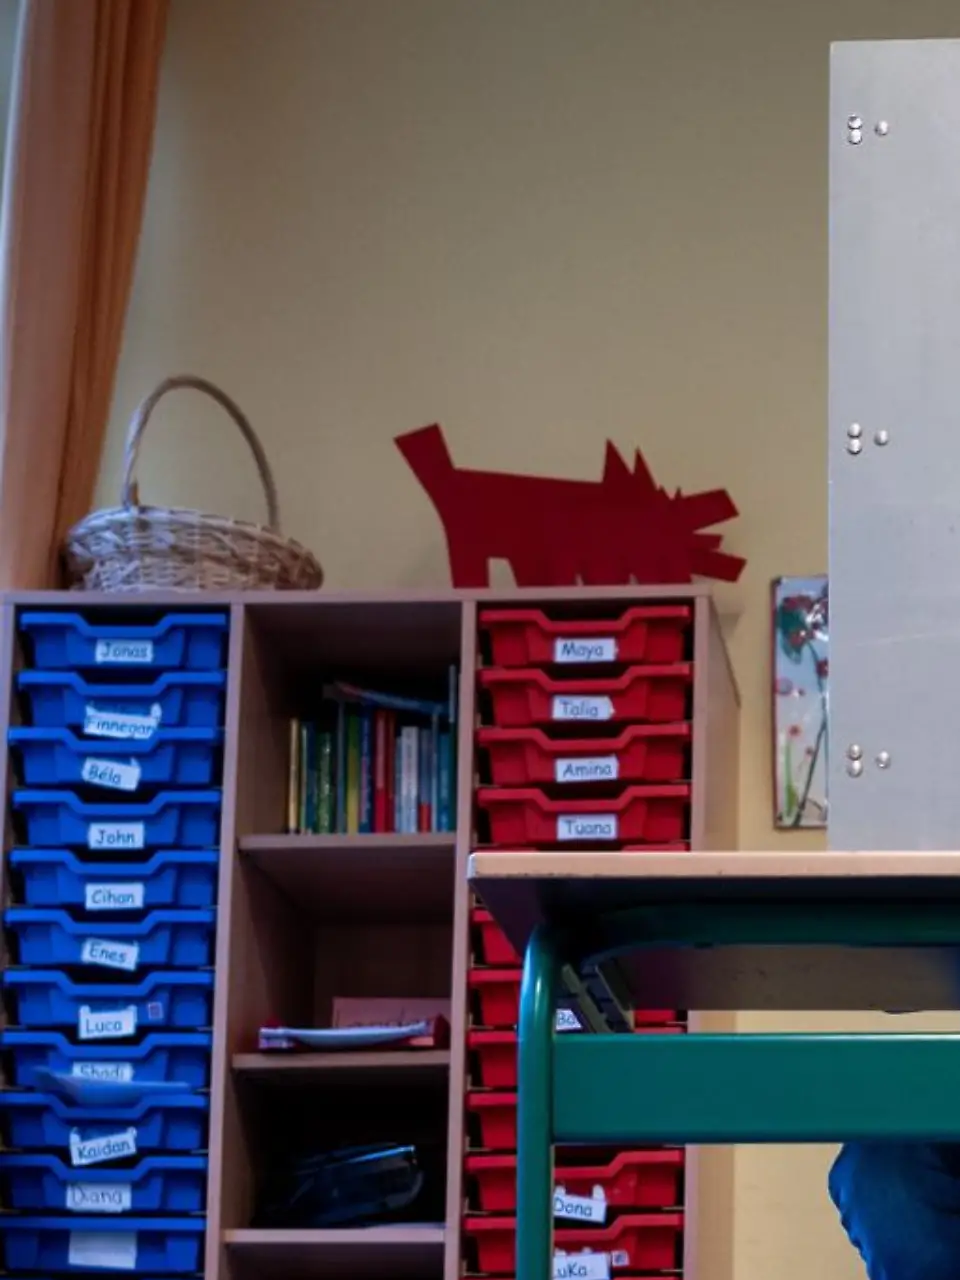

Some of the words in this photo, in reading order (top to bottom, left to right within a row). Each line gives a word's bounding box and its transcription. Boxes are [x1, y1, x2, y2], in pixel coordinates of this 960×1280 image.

[100, 640, 148, 660] Jonas
[562, 643, 604, 658] Maya
[88, 764, 122, 785] Béla
[563, 763, 612, 776] Amina
[564, 820, 612, 834] Tuana
[96, 829, 135, 846] John
[91, 889, 136, 904] Cihan
[87, 946, 127, 964] Enes
[85, 1018, 123, 1034] Luca
[76, 1136, 131, 1161] Kaidan
[553, 1263, 588, 1279] uKa
